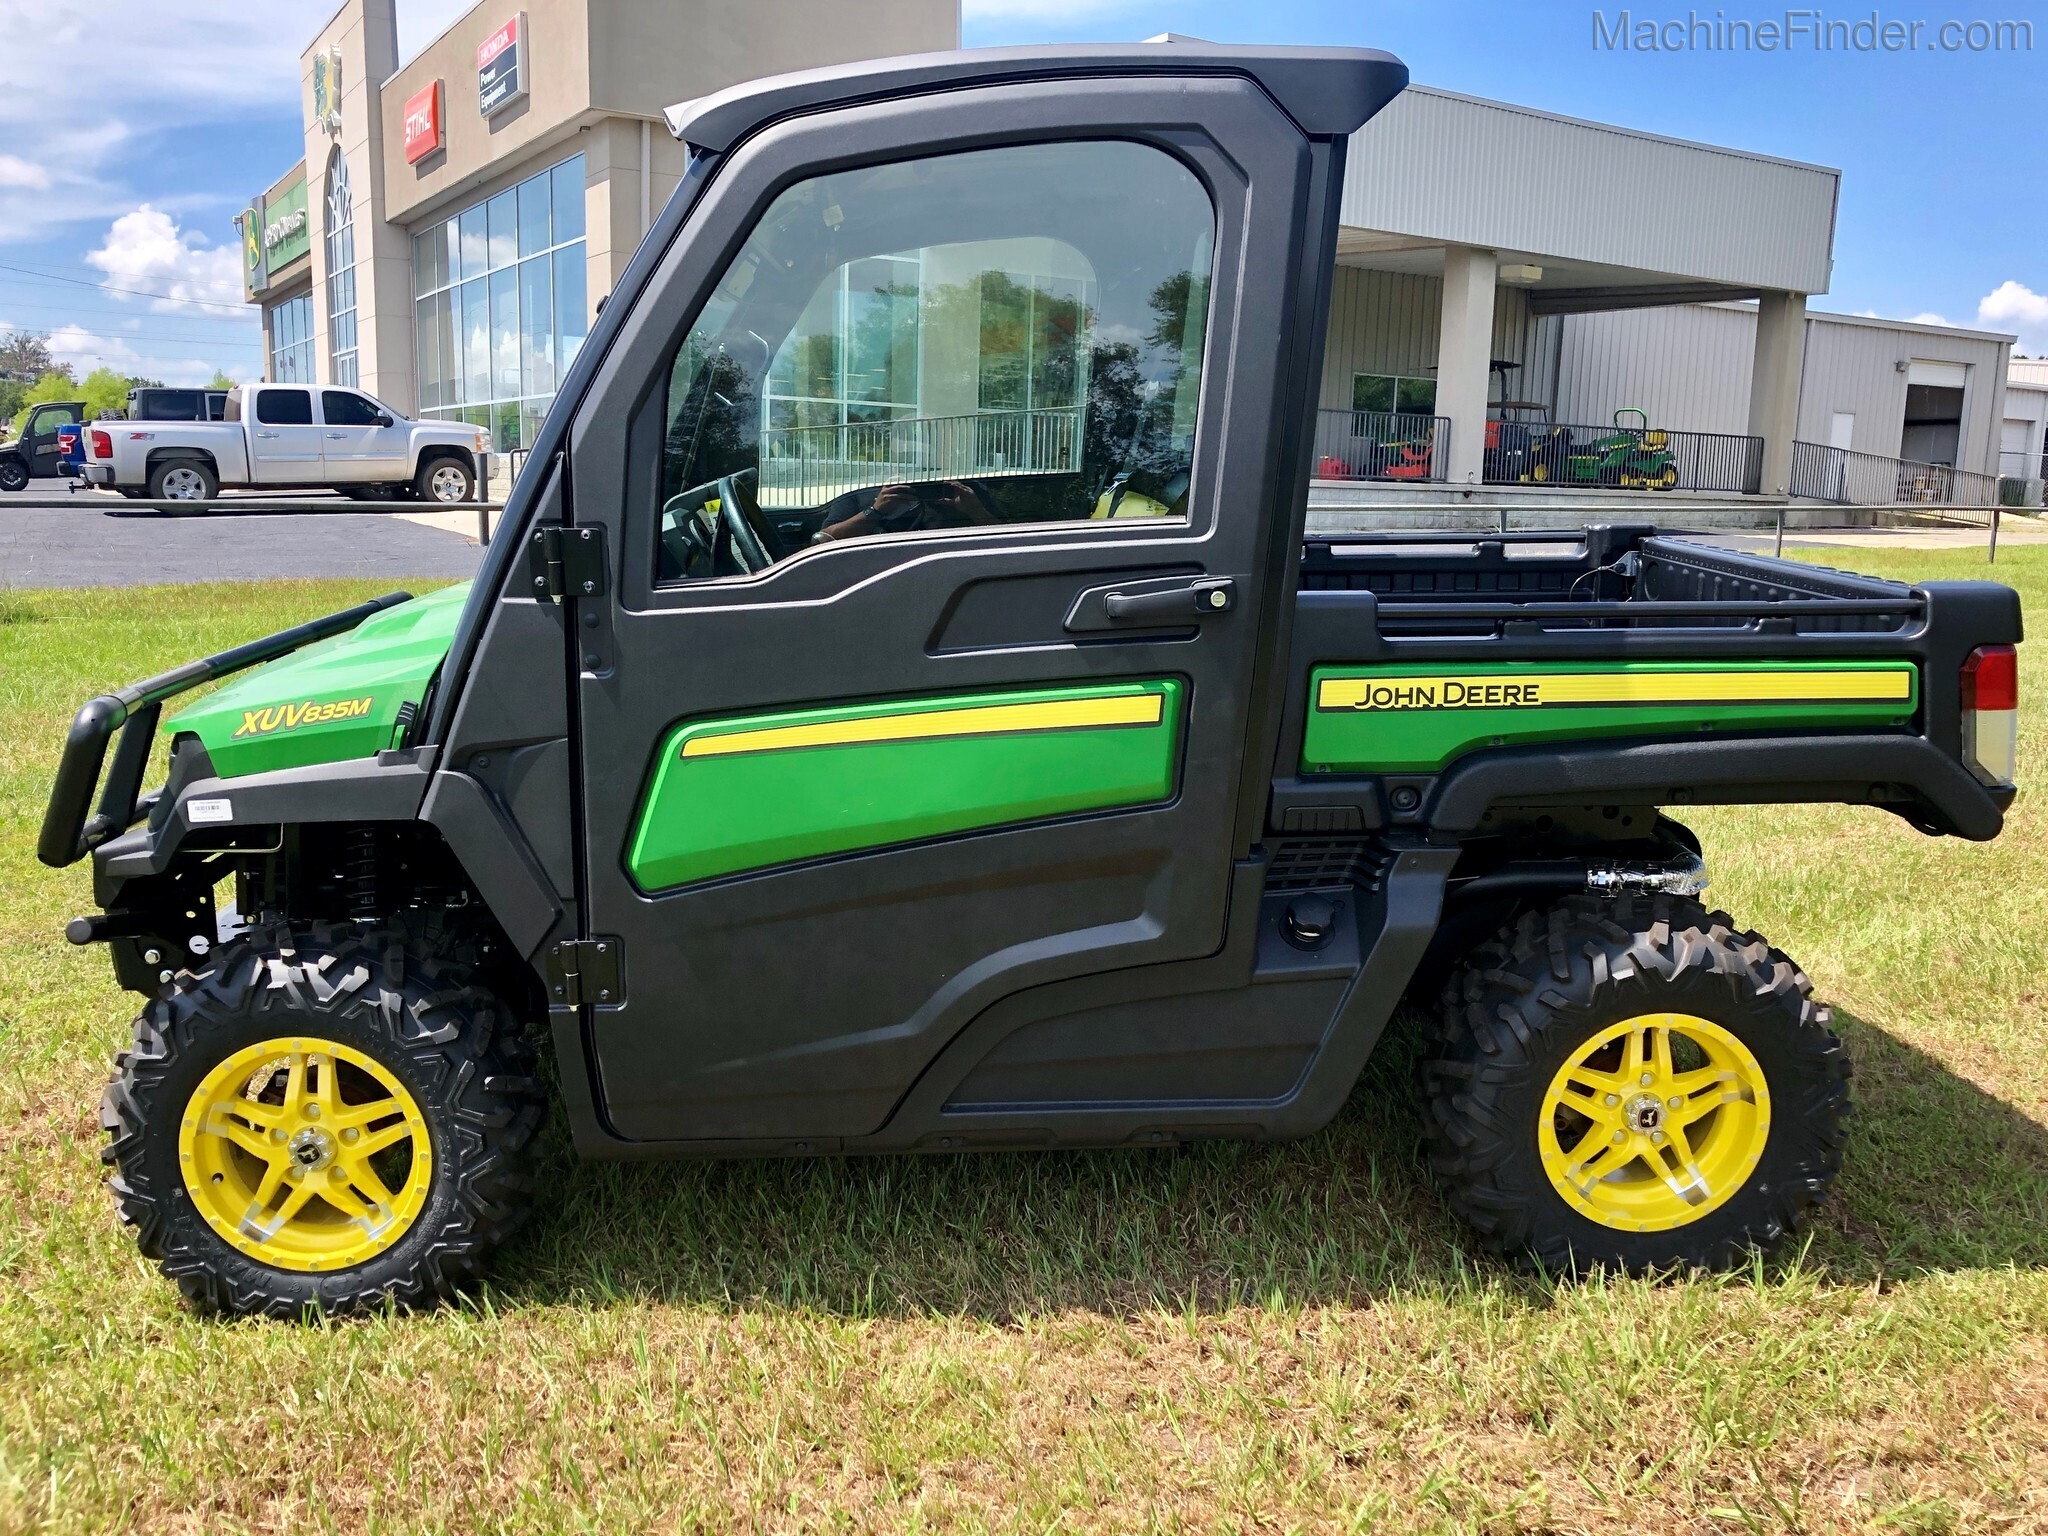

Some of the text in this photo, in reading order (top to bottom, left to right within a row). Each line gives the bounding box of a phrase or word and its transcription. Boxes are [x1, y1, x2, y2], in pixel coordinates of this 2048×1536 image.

[480, 29, 509, 64] HONDA
[480, 67, 496, 87] Power
[480, 80, 507, 109] Equipment
[405, 103, 431, 144] STIHL
[1354, 682, 1540, 707] JOHN DEERE
[233, 697, 373, 737] XUV835M
